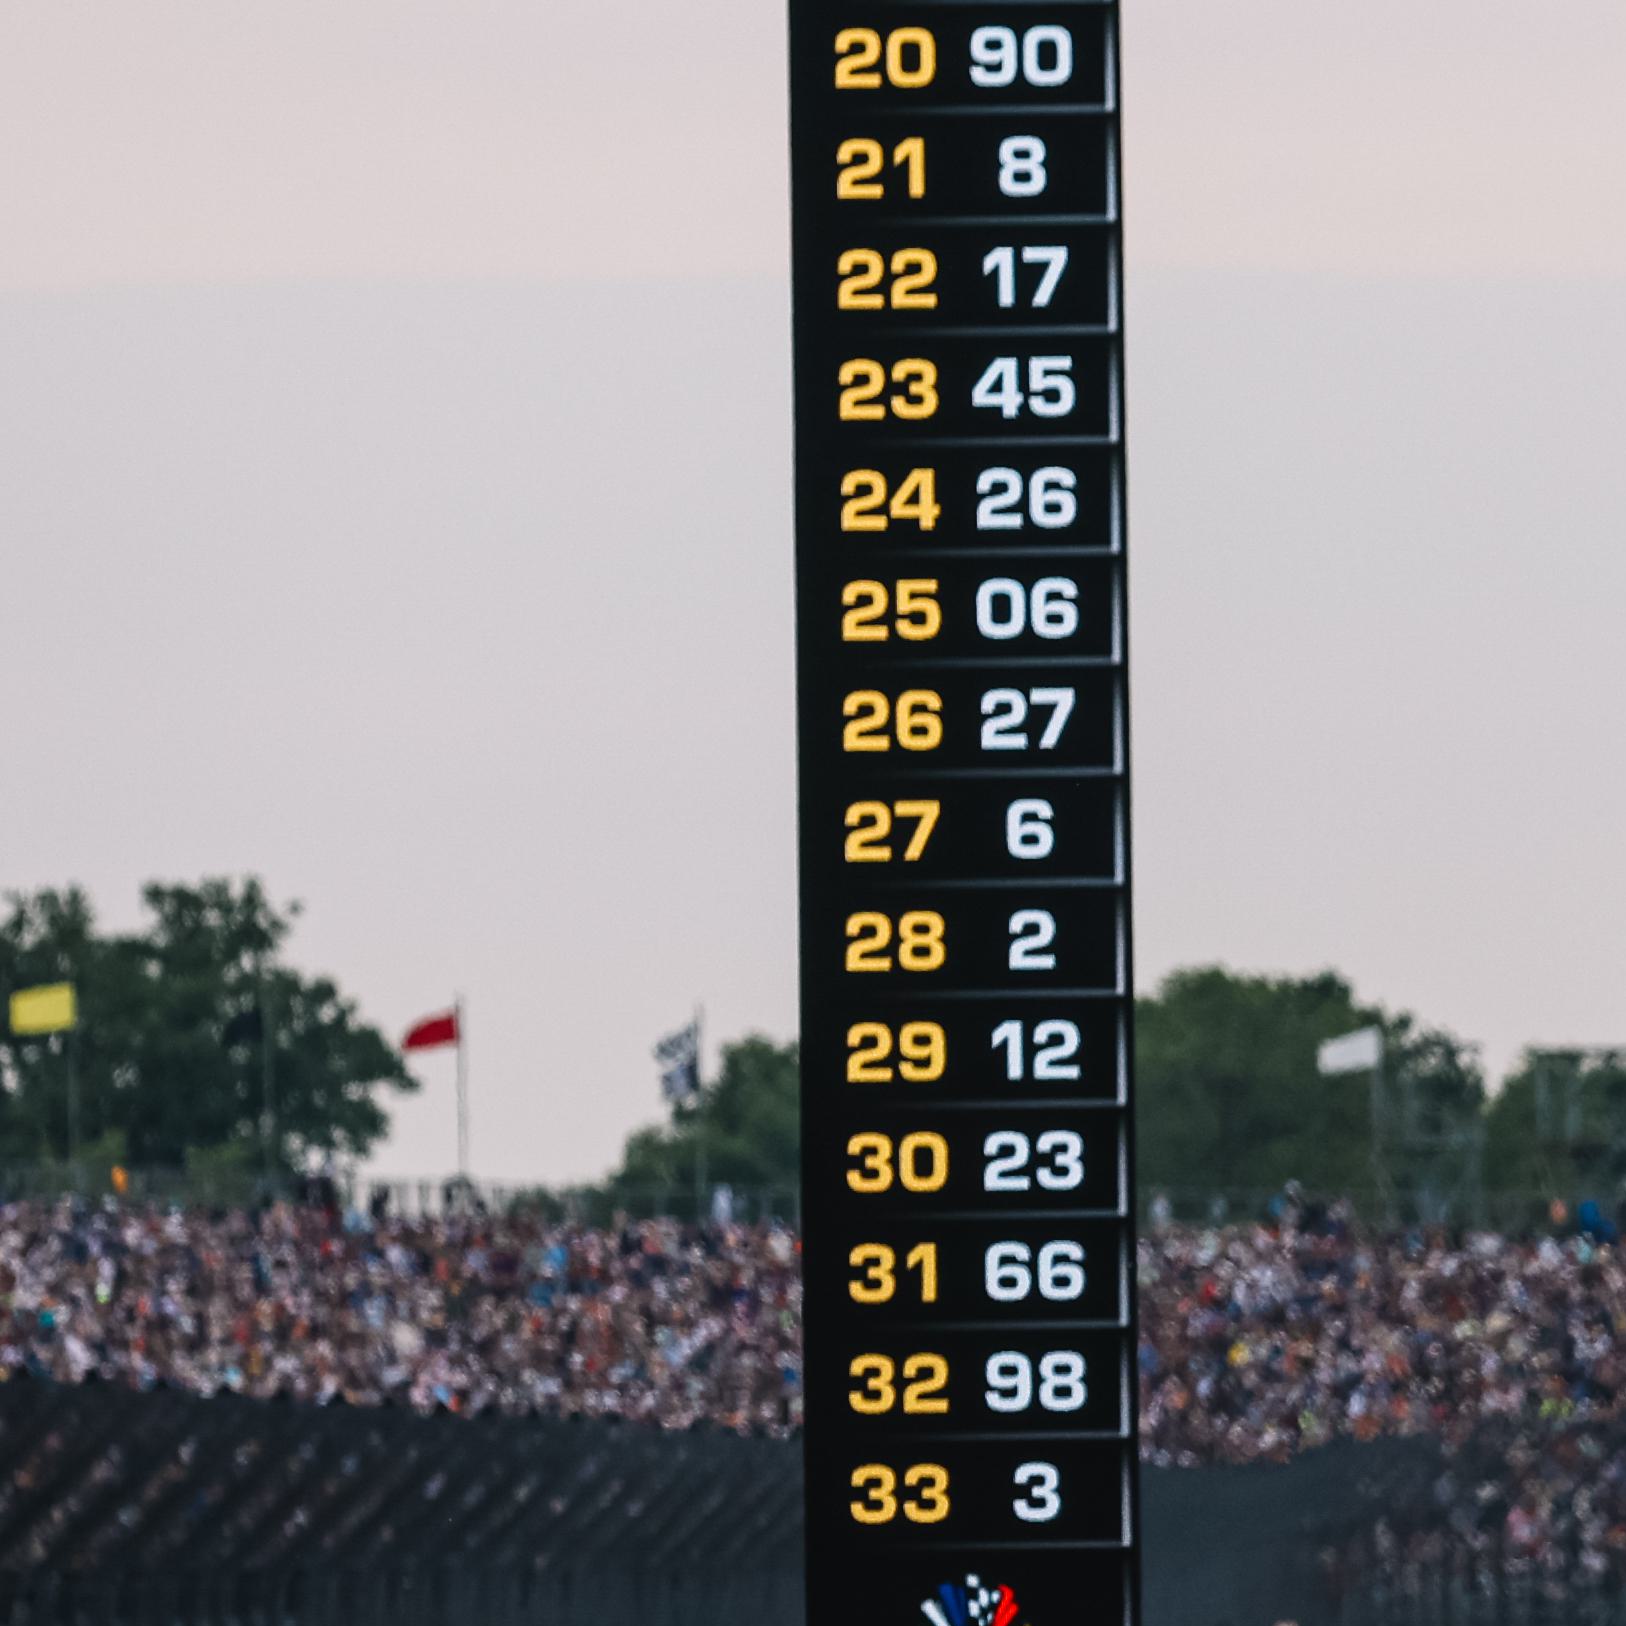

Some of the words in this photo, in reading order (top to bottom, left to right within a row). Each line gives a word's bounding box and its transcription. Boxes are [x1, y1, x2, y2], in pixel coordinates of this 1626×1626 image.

[834, 27, 936, 89] 20
[969, 25, 1073, 87] 90
[836, 137, 925, 199] 21
[998, 135, 1047, 197] 8
[837, 247, 938, 310] 22
[983, 245, 1069, 308] 17
[838, 358, 939, 420] 23
[971, 355, 1076, 418] 45
[840, 468, 941, 531] 24
[976, 466, 1077, 529] 26
[842, 579, 941, 641] 25
[975, 577, 1079, 640] 06
[842, 689, 943, 752] 26
[980, 687, 1076, 750] 27
[844, 799, 941, 862] 27
[1006, 798, 1054, 859] 6
[845, 910, 945, 972] 28
[1008, 909, 1056, 970] 2
[847, 1021, 946, 1083] 29
[991, 1019, 1081, 1080] 12
[846, 1131, 948, 1193] 30
[983, 1130, 1084, 1191] 23
[848, 1243, 937, 1303] 31
[984, 1240, 1085, 1301] 66
[848, 1353, 949, 1414] 32
[984, 1350, 1086, 1412] 98
[850, 1463, 950, 1524] 33
[1012, 1462, 1061, 1522] 3
